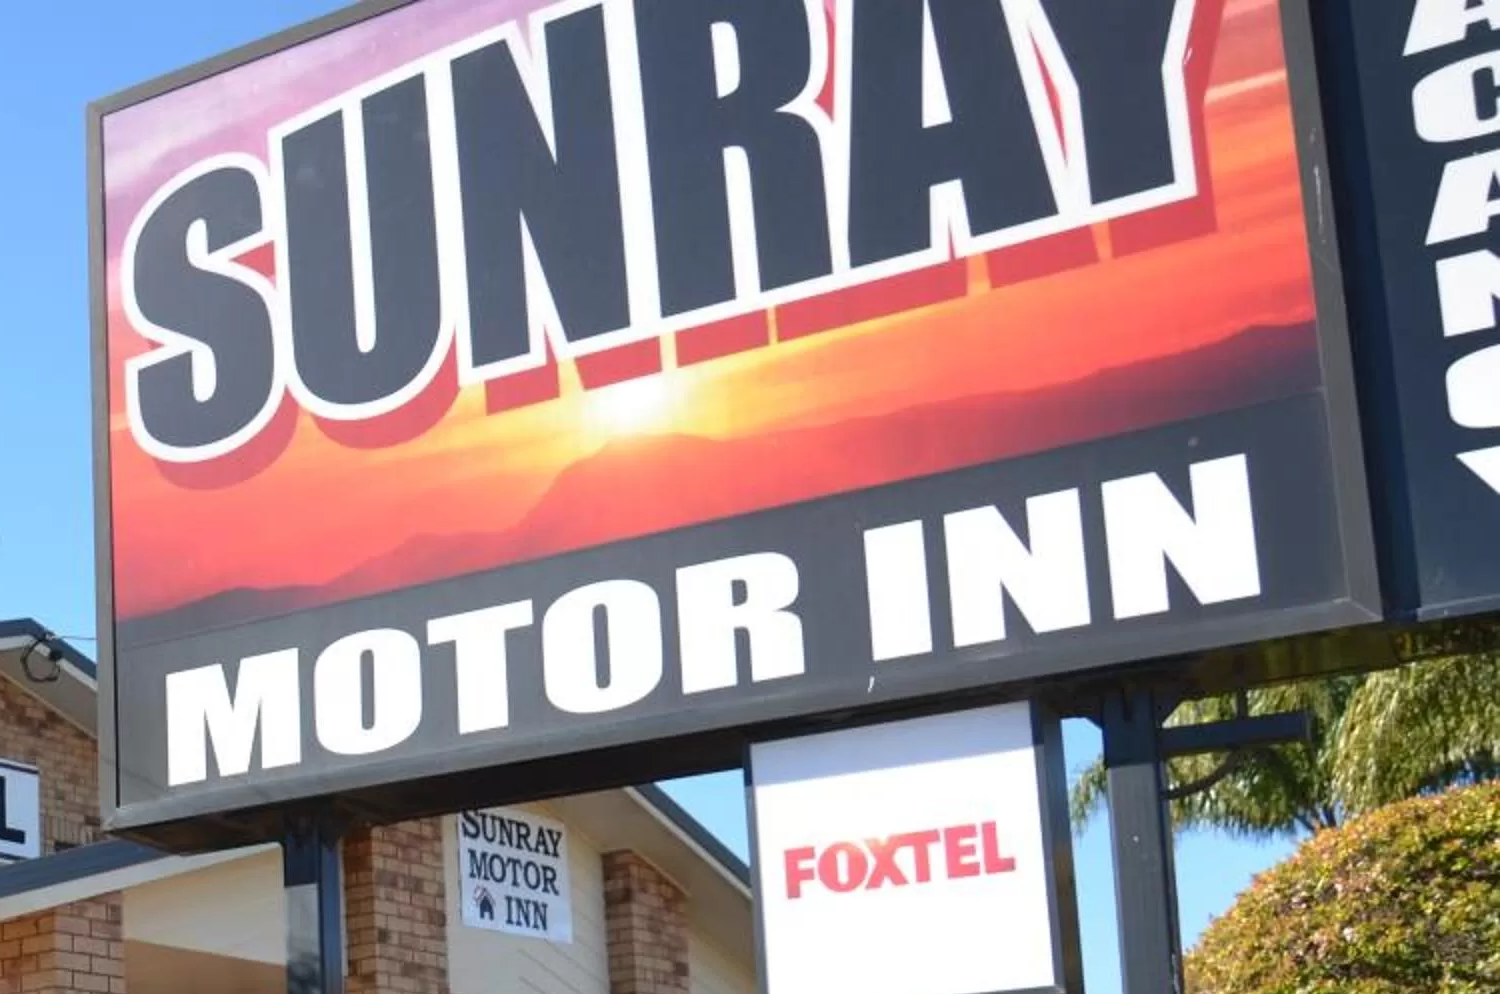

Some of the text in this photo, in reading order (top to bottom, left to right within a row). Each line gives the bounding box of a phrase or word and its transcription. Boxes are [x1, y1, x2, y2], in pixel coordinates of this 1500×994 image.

[122, 0, 1198, 463] SUNRAY
[165, 453, 1261, 787] MOTOR INN
[461, 808, 563, 858] SUNRAY
[784, 820, 1016, 899] FOXTEL
[467, 848, 560, 896] MOTOR
[504, 895, 548, 931] INN
